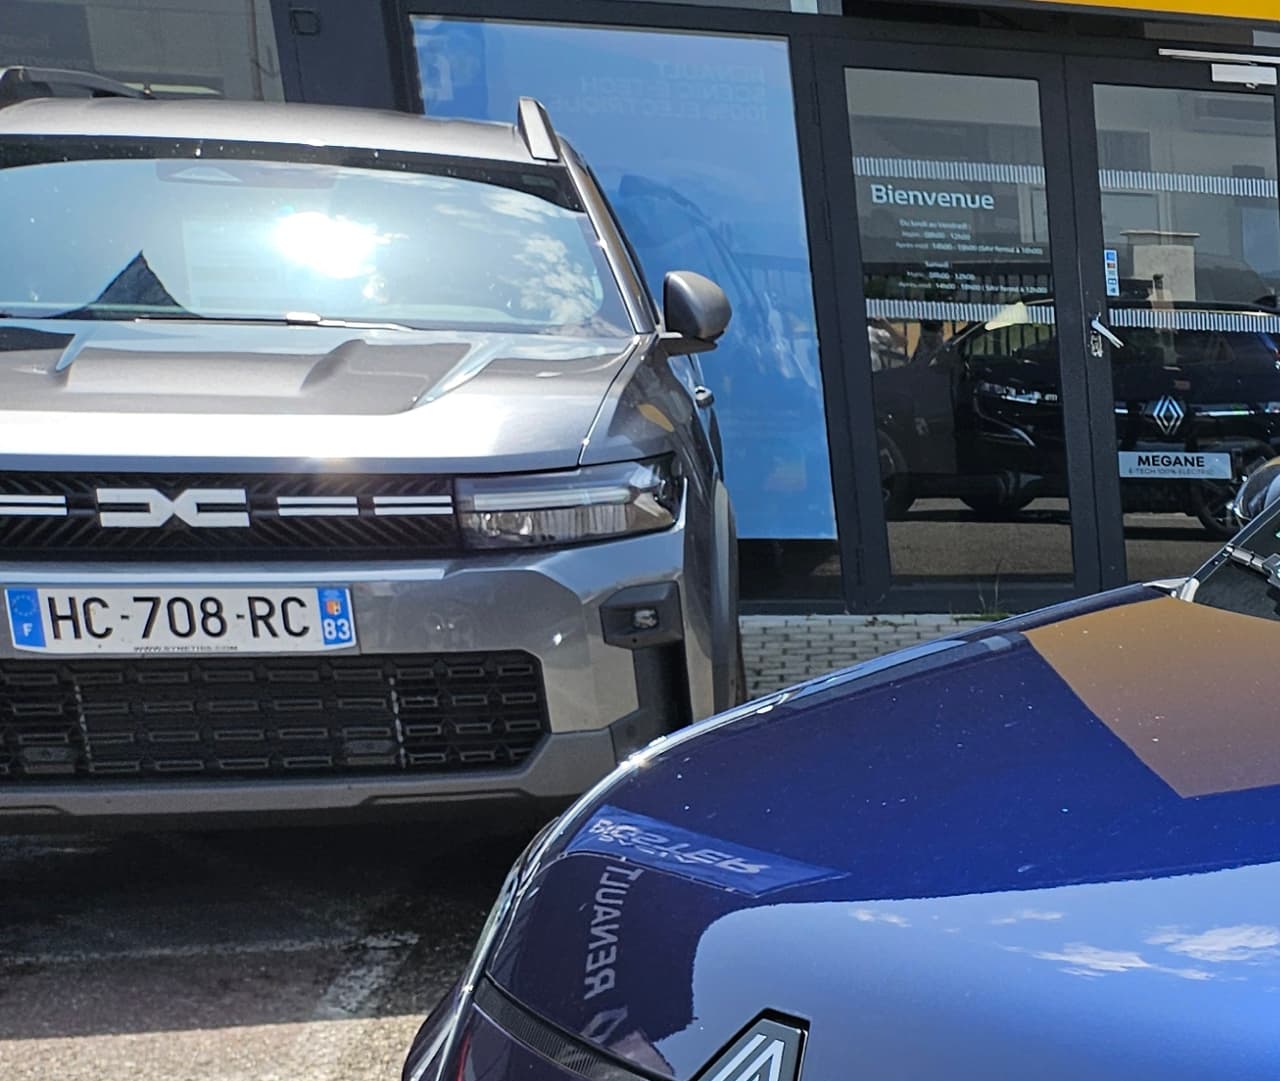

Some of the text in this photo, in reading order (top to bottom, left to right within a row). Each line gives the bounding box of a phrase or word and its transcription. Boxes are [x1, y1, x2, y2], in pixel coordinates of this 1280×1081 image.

[870, 184, 995, 210] Bienvenue
[1137, 455, 1205, 467] MEGANE
[48, 596, 310, 640] HC-708-RC
[323, 618, 350, 639] 83
[24, 623, 32, 637] F
